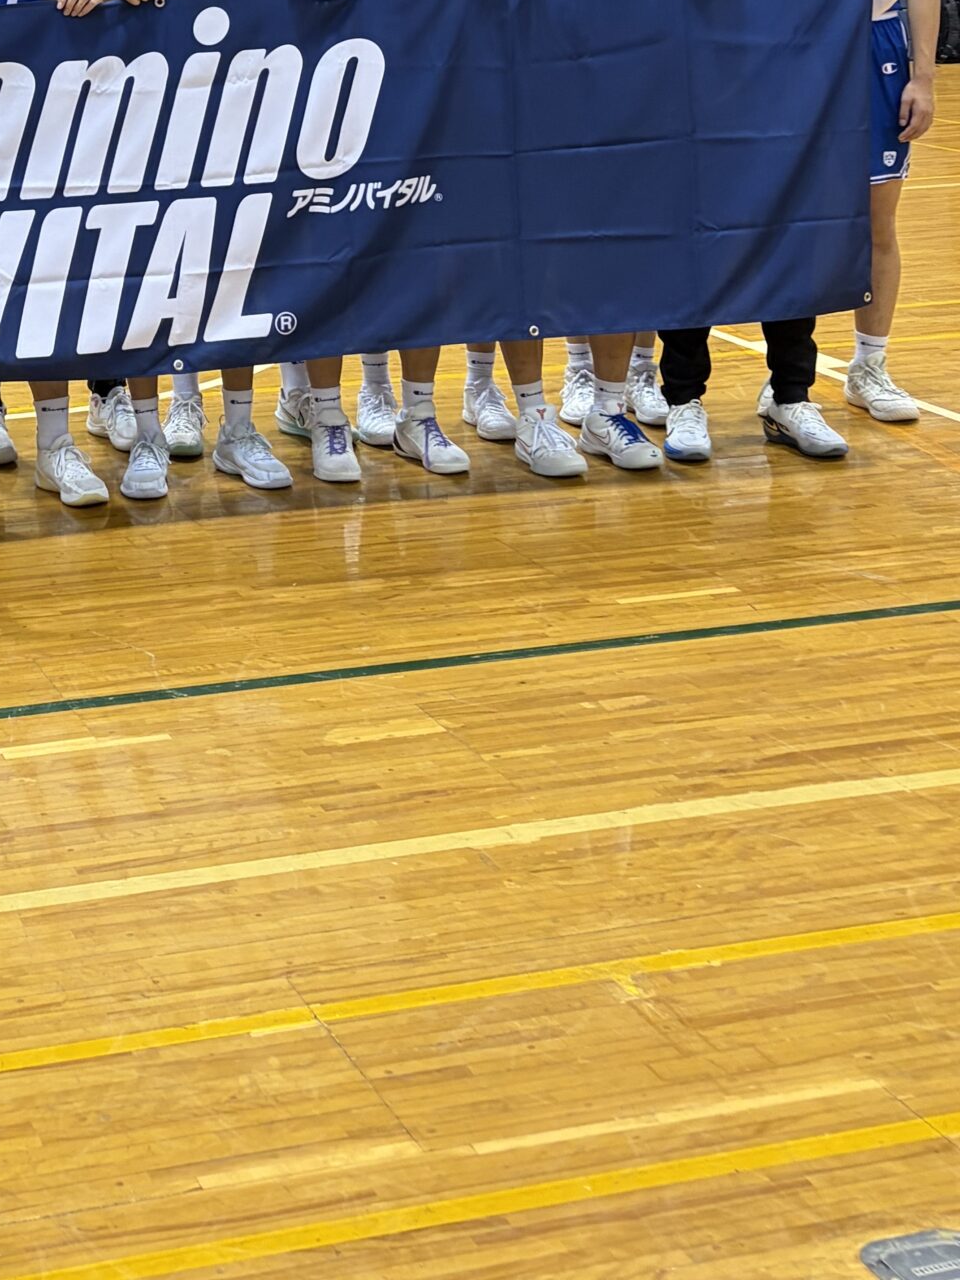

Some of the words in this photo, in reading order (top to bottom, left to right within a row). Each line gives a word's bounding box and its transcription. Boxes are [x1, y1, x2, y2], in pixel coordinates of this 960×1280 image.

[286, 174, 437, 219] アミノバイタル
